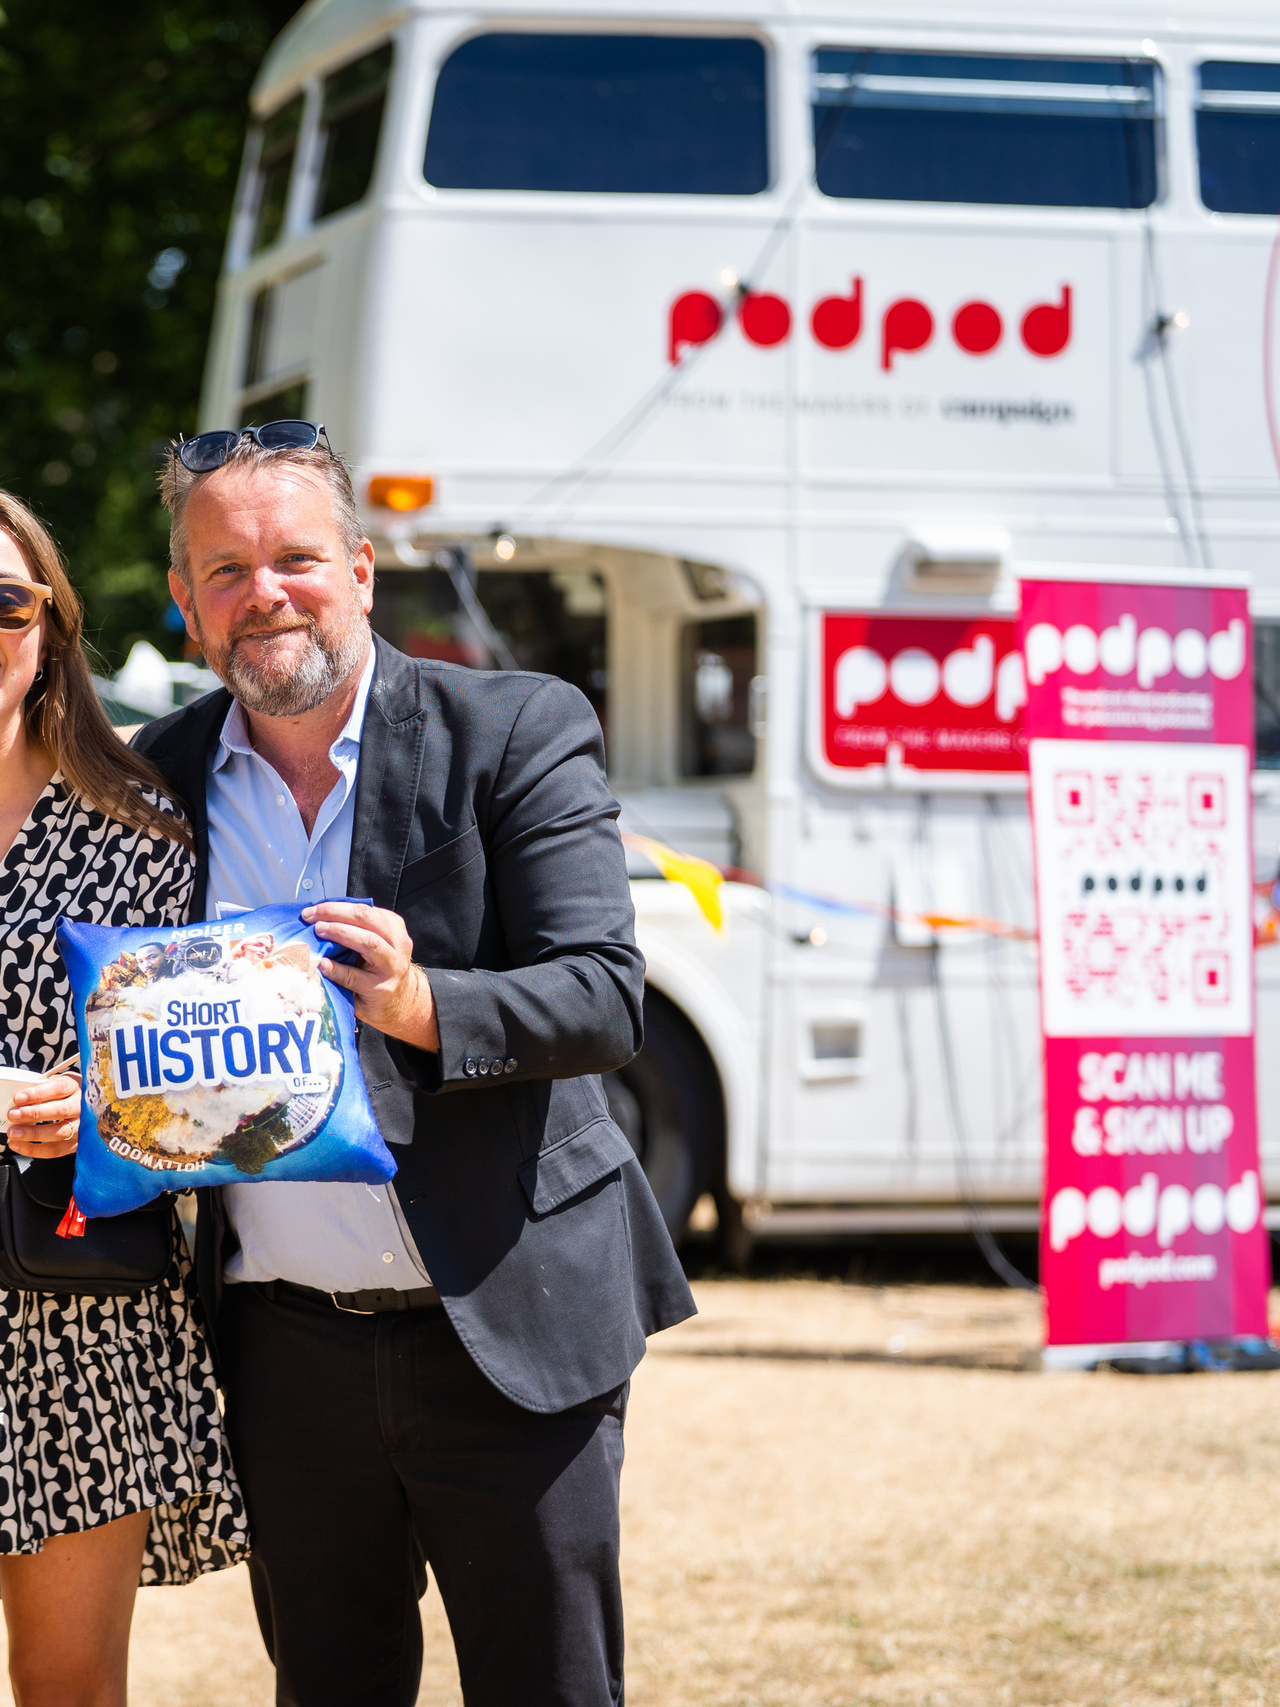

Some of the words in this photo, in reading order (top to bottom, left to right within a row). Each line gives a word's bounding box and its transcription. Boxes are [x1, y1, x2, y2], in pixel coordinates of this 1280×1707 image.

[668, 275, 1073, 373] podpod
[835, 633, 1026, 722] podp
[1026, 613, 1245, 688] podpod
[1081, 869, 1207, 901] podpod
[167, 999, 241, 1027] SHORT
[115, 1019, 316, 1092] HISTORY
[1078, 1051, 1173, 1102] SCAN
[1174, 1051, 1224, 1101] ME
[108, 1136, 206, 1172] HOLLYWOOD
[1072, 1105, 1102, 1157] &
[1103, 1105, 1184, 1156] SIGN
[1186, 1104, 1234, 1155] UP
[1050, 1169, 1260, 1253] podpod
